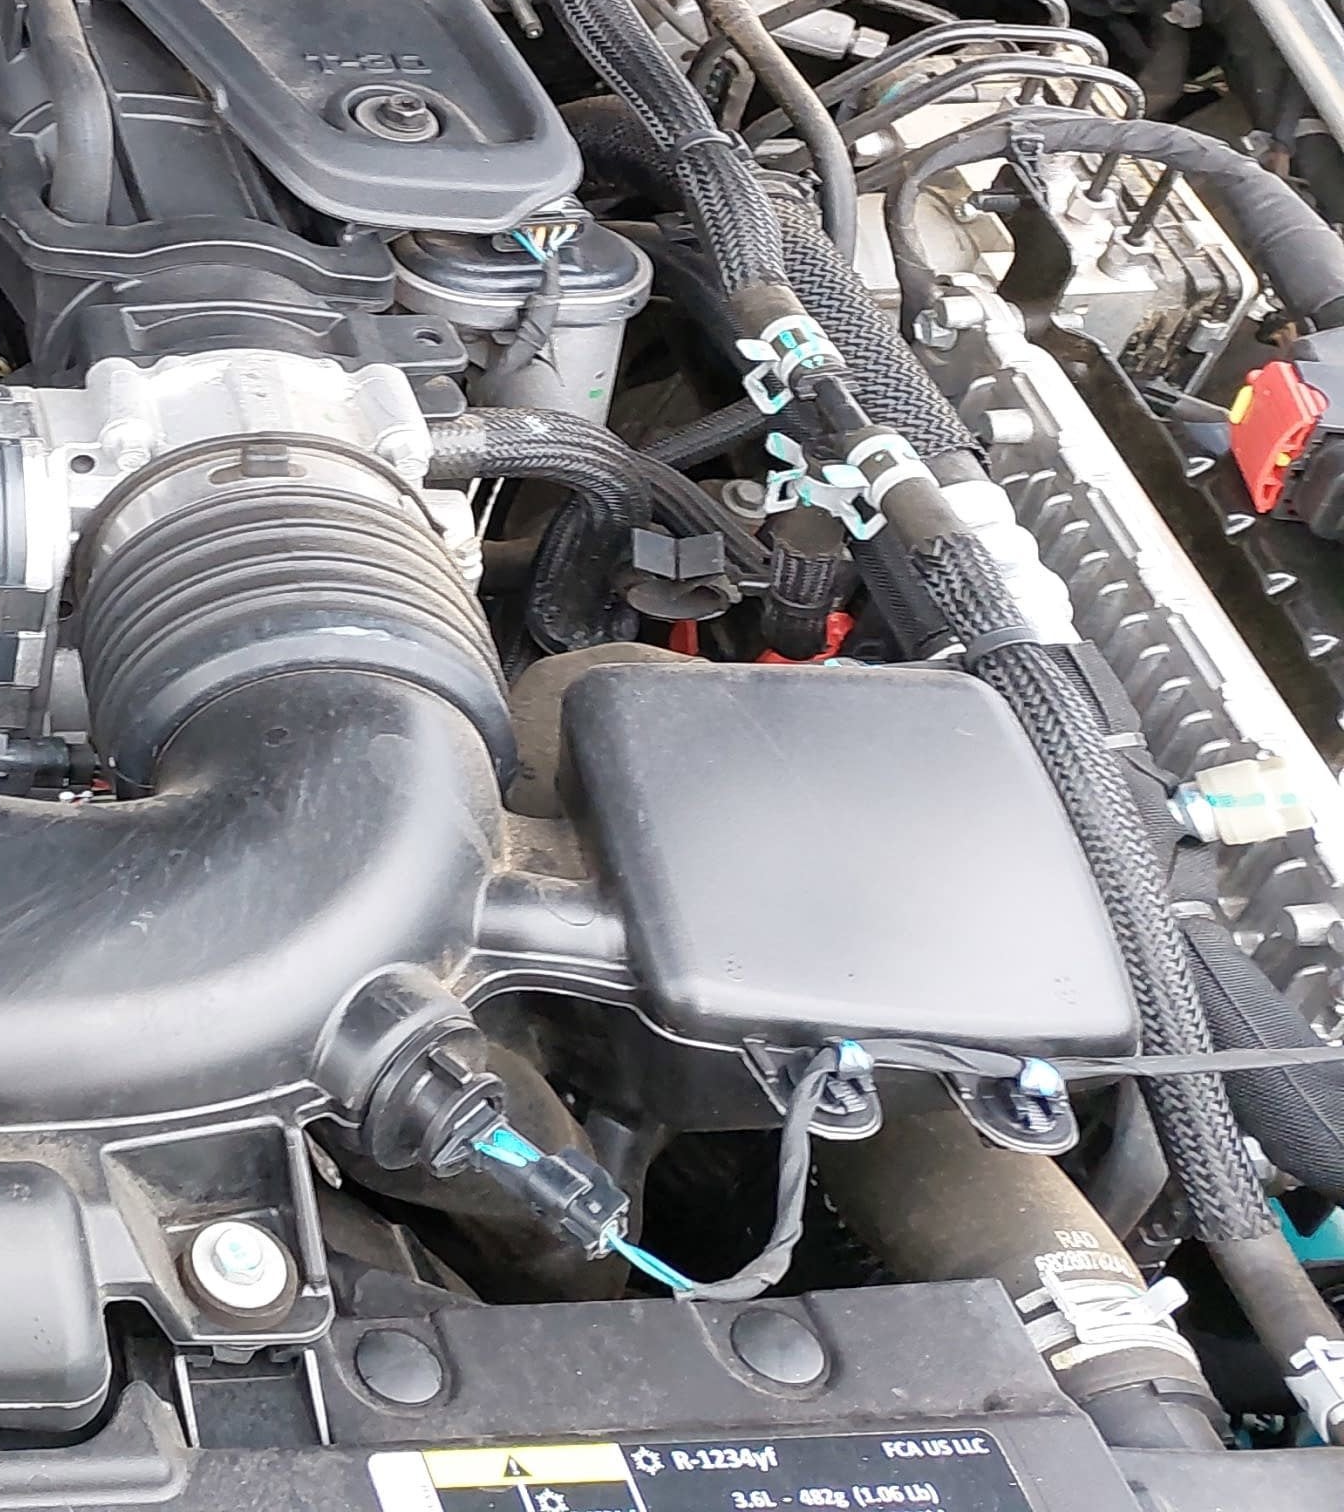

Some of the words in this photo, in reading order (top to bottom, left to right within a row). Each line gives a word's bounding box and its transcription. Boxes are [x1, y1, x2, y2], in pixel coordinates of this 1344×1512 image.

[1053, 1230, 1099, 1249] RAD
[672, 1447, 779, 1472] R-1234yf
[881, 1441, 921, 1458] FCA
[922, 1439, 953, 1457] US
[954, 1437, 991, 1455] LLC
[733, 1490, 776, 1508] 3.6L
[855, 1485, 905, 1508] (1.06
